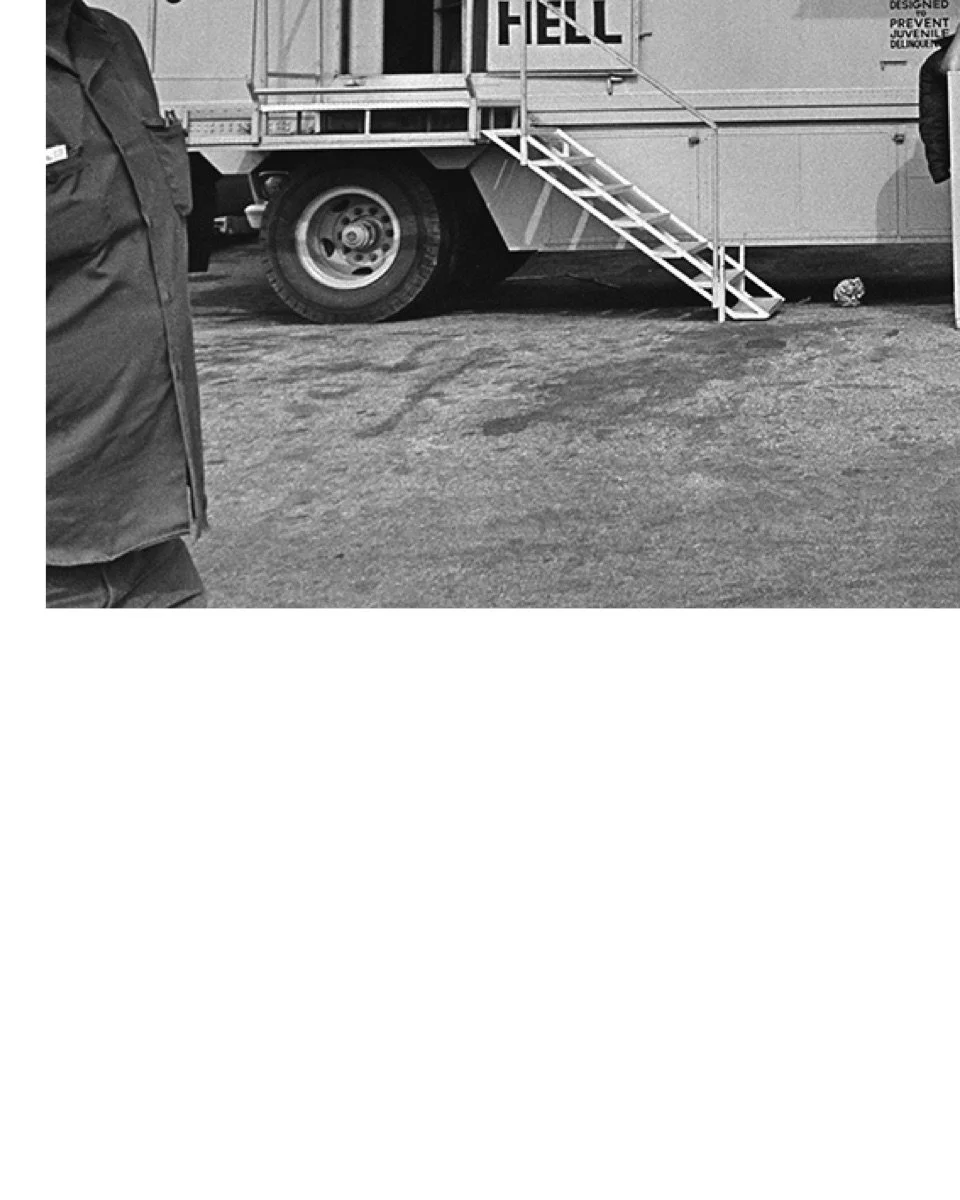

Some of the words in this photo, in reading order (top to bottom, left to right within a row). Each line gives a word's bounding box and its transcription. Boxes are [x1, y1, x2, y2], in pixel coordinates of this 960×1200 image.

[889, 0, 949, 10] DESIGNED
[498, 0, 622, 45] HELL
[889, 17, 949, 28] PREVENT
[890, 28, 949, 38] JUVENILE
